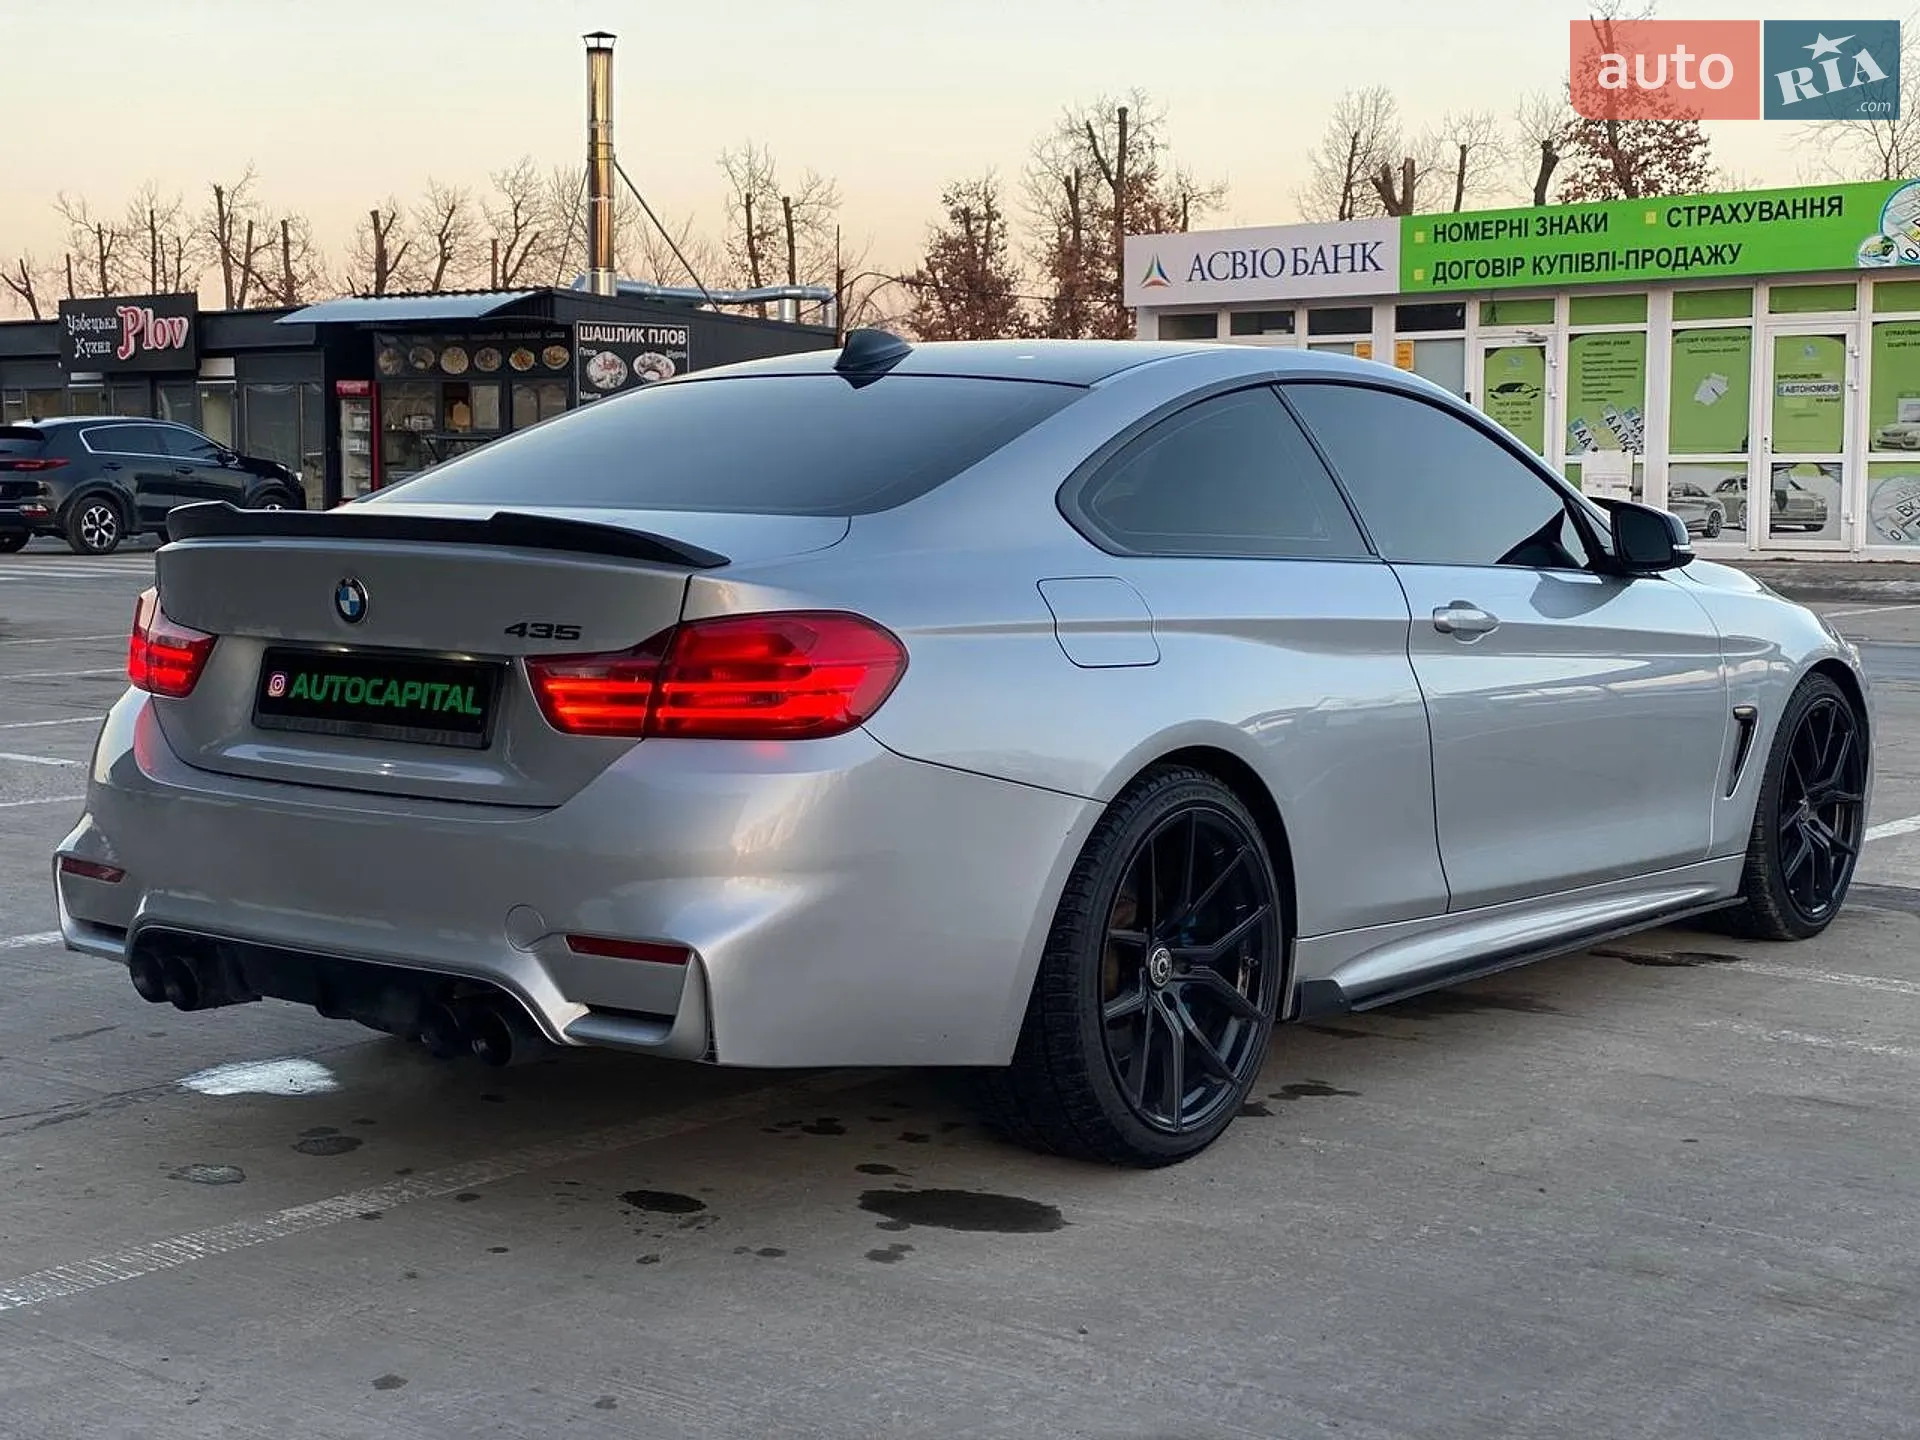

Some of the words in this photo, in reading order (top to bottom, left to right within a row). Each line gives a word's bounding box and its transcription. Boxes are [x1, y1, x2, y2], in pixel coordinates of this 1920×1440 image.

[1433, 217, 1529, 244] НОМЕРНІ
[1535, 212, 1609, 237] ЗНАКИ
[1666, 195, 1844, 228] СТРАХУВАННЯ
[1187, 247, 1285, 282] АСВІО
[1290, 241, 1385, 277] БАНК
[1432, 256, 1526, 285] ДОГОВІР
[1532, 243, 1743, 275] КУПІВЛІ-ПРОДАЖУ
[65, 312, 118, 336] Узбецька
[116, 305, 189, 360] Plov
[579, 325, 645, 343] ШАШЛИК
[647, 328, 687, 345] ПЛОВ
[504, 622, 583, 641] 435
[289, 672, 483, 716] AUTOCAPITAL
